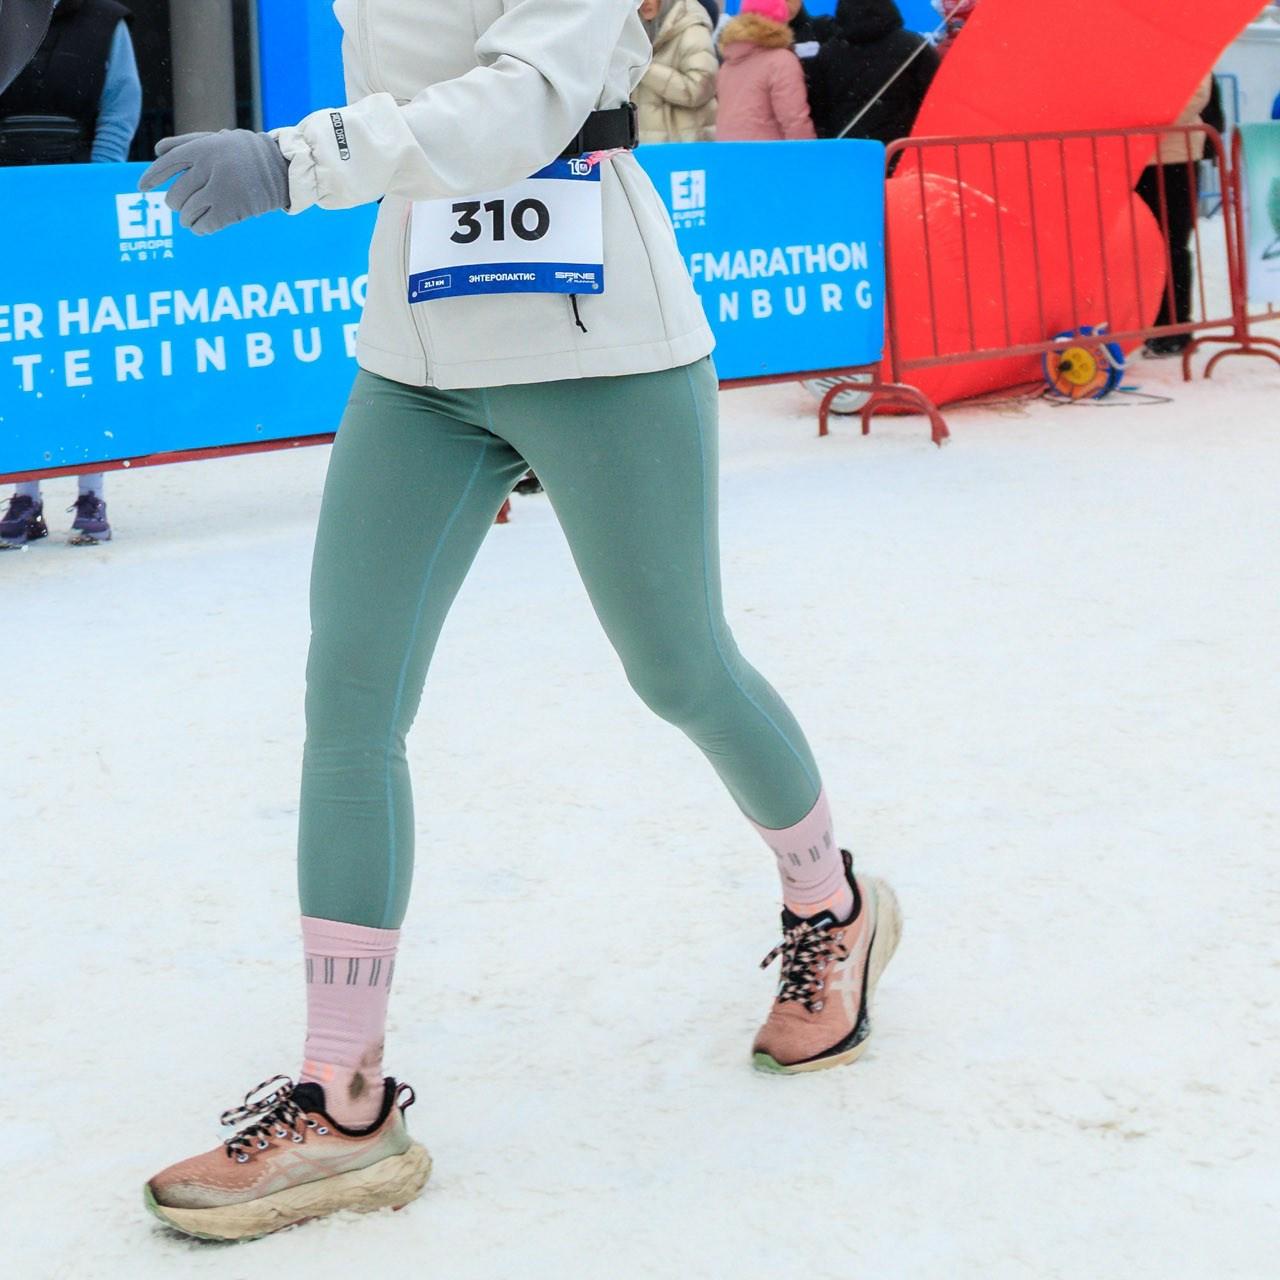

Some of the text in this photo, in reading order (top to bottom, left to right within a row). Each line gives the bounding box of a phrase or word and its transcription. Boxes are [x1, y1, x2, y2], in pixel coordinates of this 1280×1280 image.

[450, 198, 550, 244] 310
[120, 239, 173, 252] EUROPE
[121, 249, 174, 262] ASIA
[687, 241, 868, 284] FMARATHON
[469, 273, 536, 283] ЭНТЕРОЛАКТИС
[554, 272, 595, 280] SPINE
[58, 274, 368, 336] HALFMARATHO
